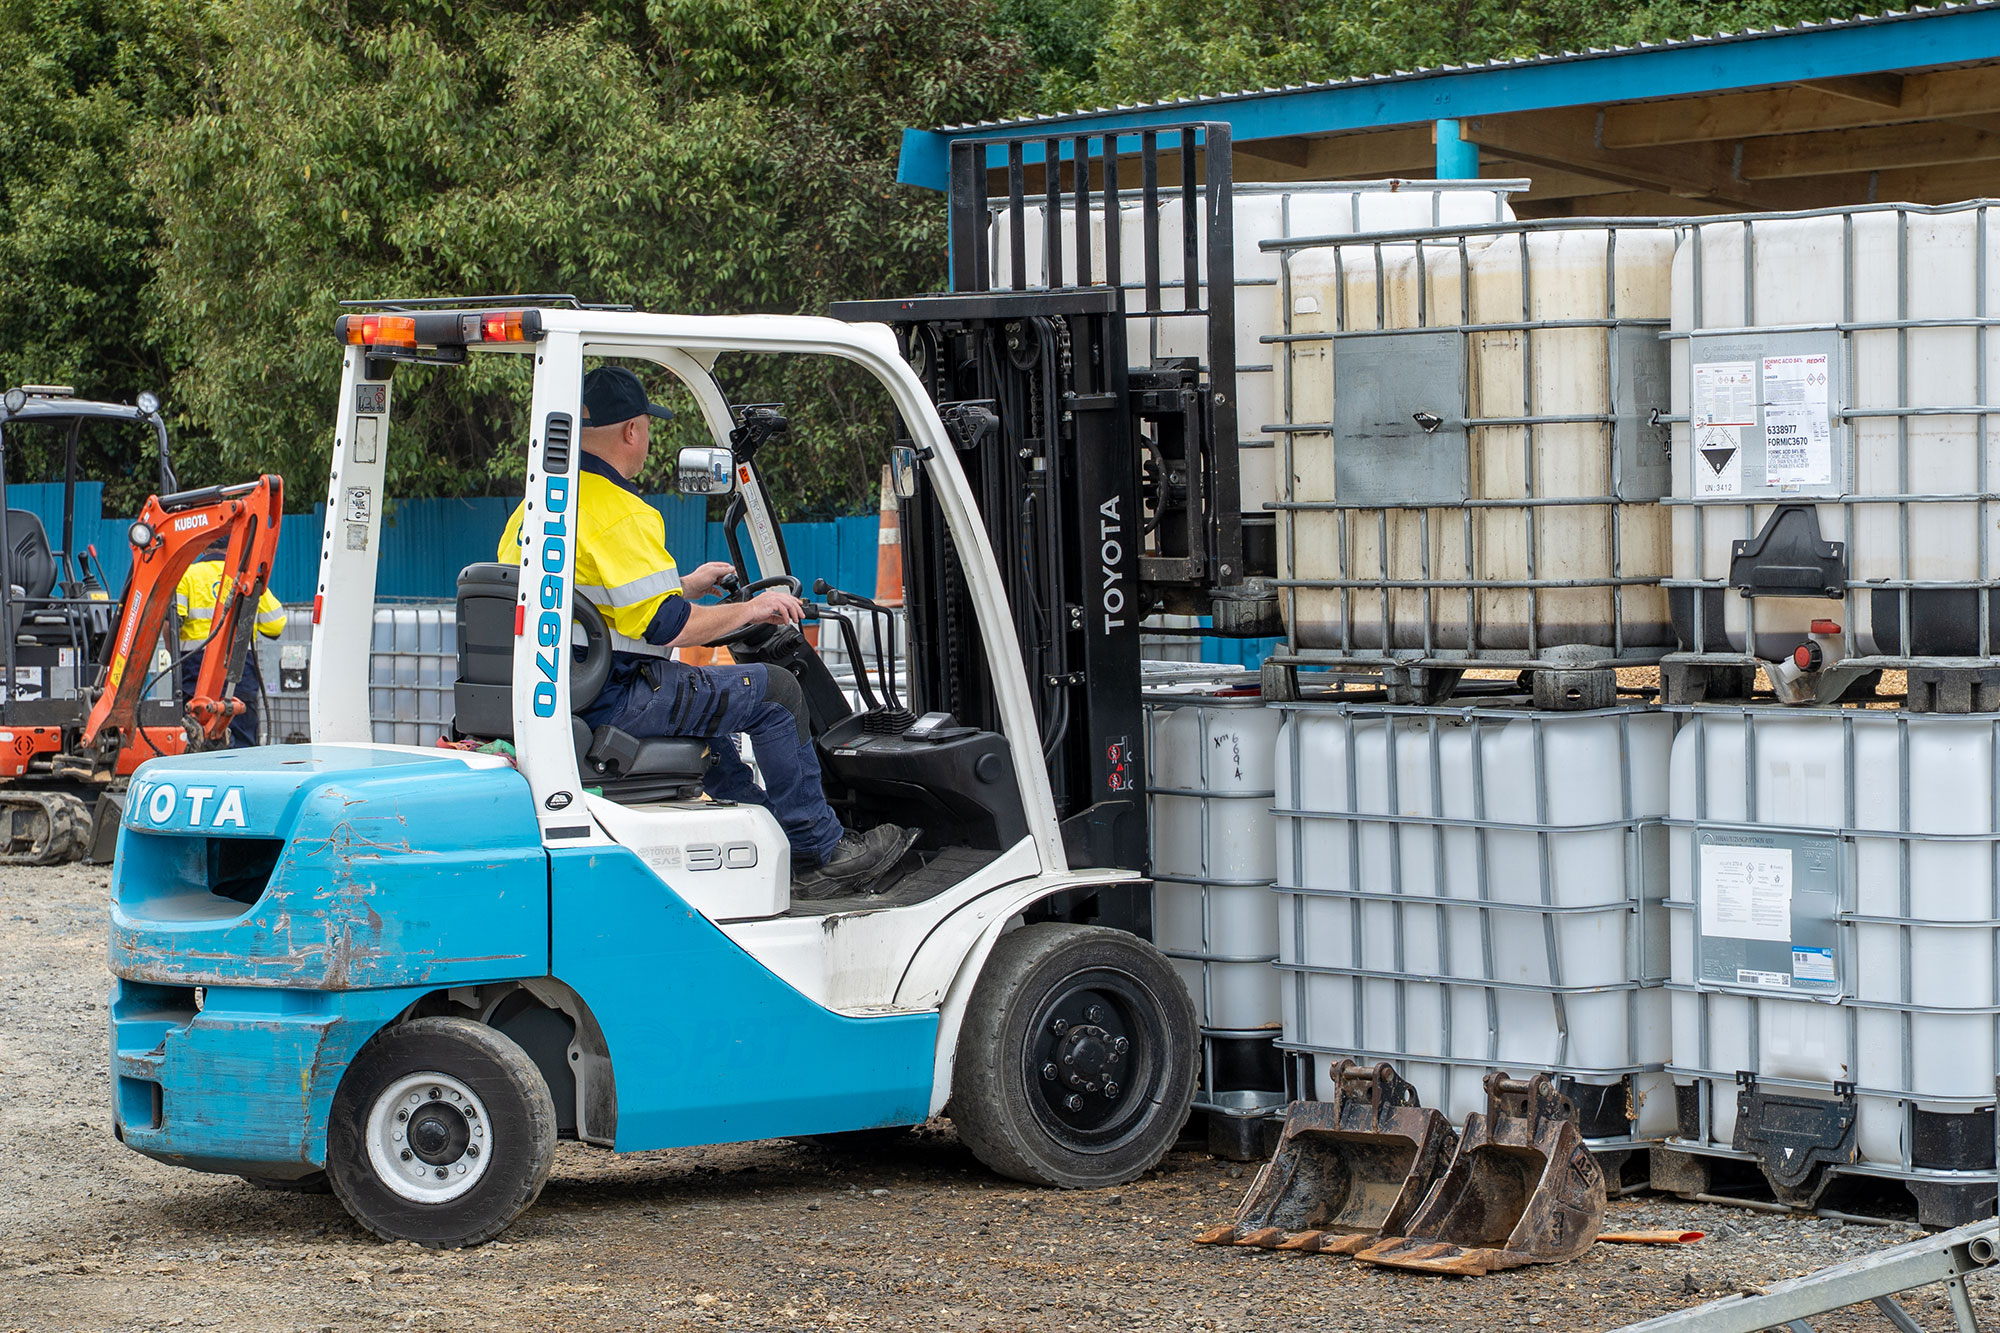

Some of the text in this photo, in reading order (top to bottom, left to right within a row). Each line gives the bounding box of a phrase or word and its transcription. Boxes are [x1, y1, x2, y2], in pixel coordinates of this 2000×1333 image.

[1767, 425, 1797, 434] 6338977
[1767, 437, 1808, 446] FORMIC3670
[174, 513, 209, 532] KUBOTA
[1100, 495, 1125, 635] TOYOTA
[533, 475, 569, 718] D105670
[126, 780, 246, 828] OYOTA
[650, 847, 681, 857] TOYOTA
[652, 857, 681, 866] SAS
[684, 839, 759, 872] 30
